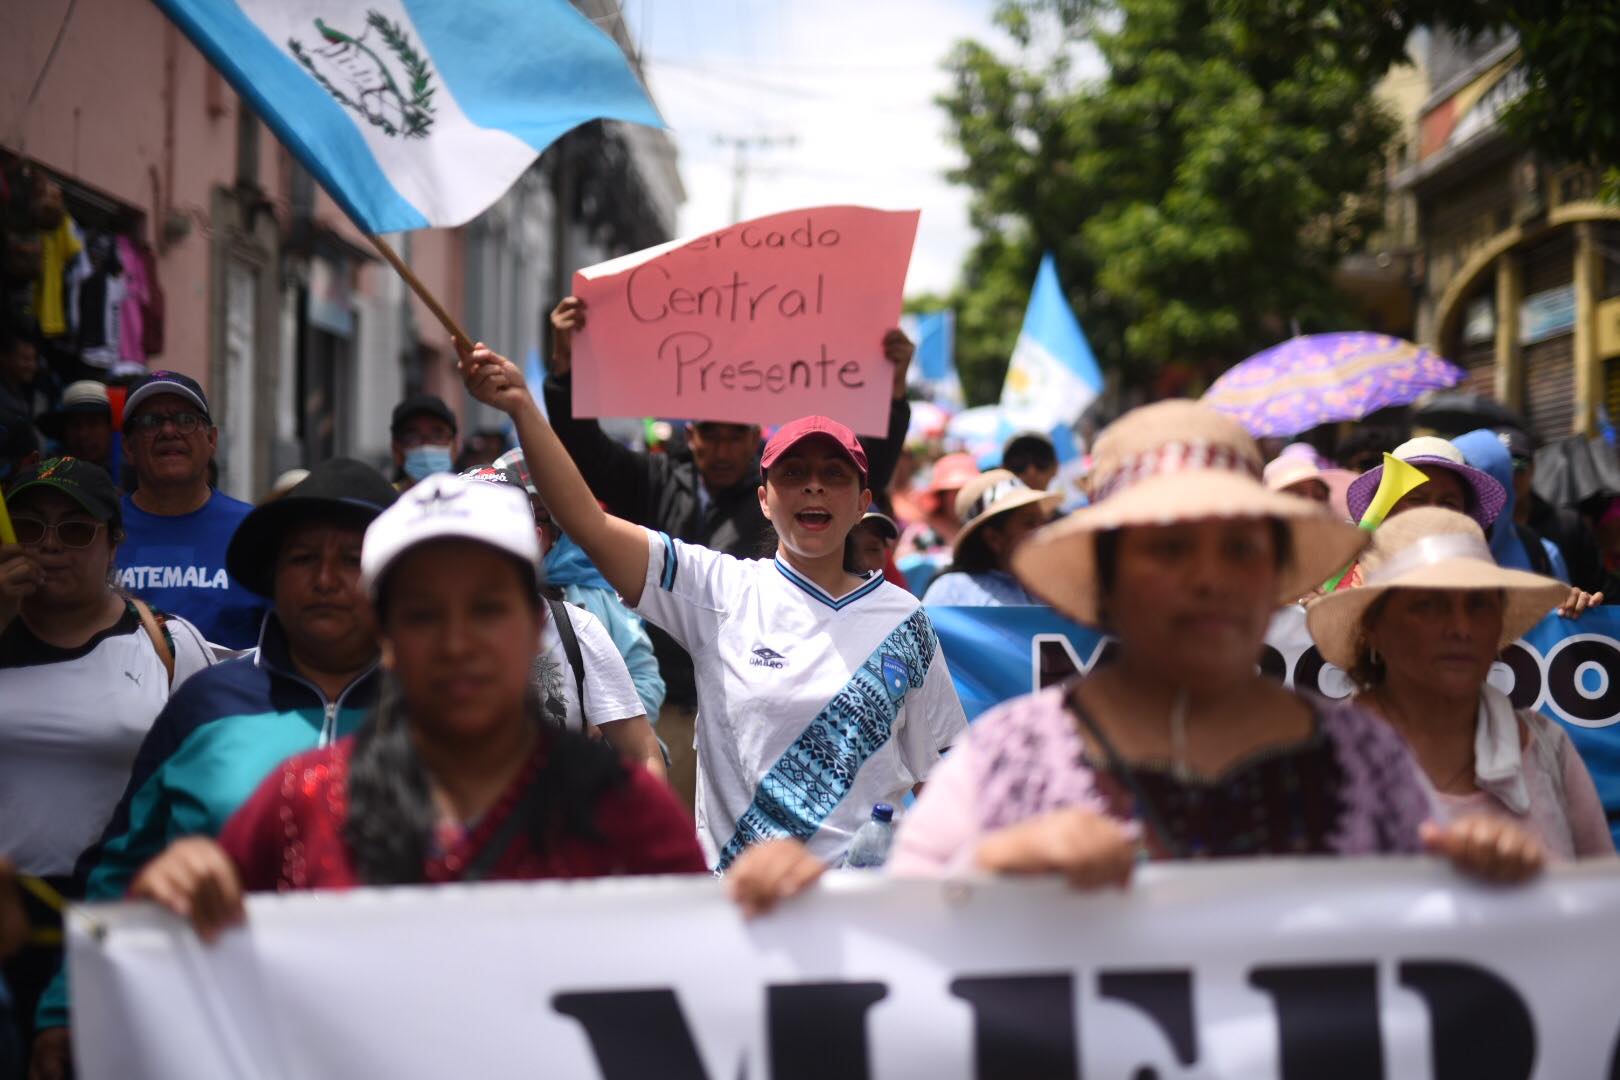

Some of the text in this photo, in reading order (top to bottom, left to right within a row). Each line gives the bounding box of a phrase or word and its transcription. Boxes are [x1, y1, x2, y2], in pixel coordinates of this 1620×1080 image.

[667, 218, 841, 254] ercado
[626, 264, 824, 322] Central
[658, 331, 865, 396] Presente
[749, 657, 783, 669] UMBRO
